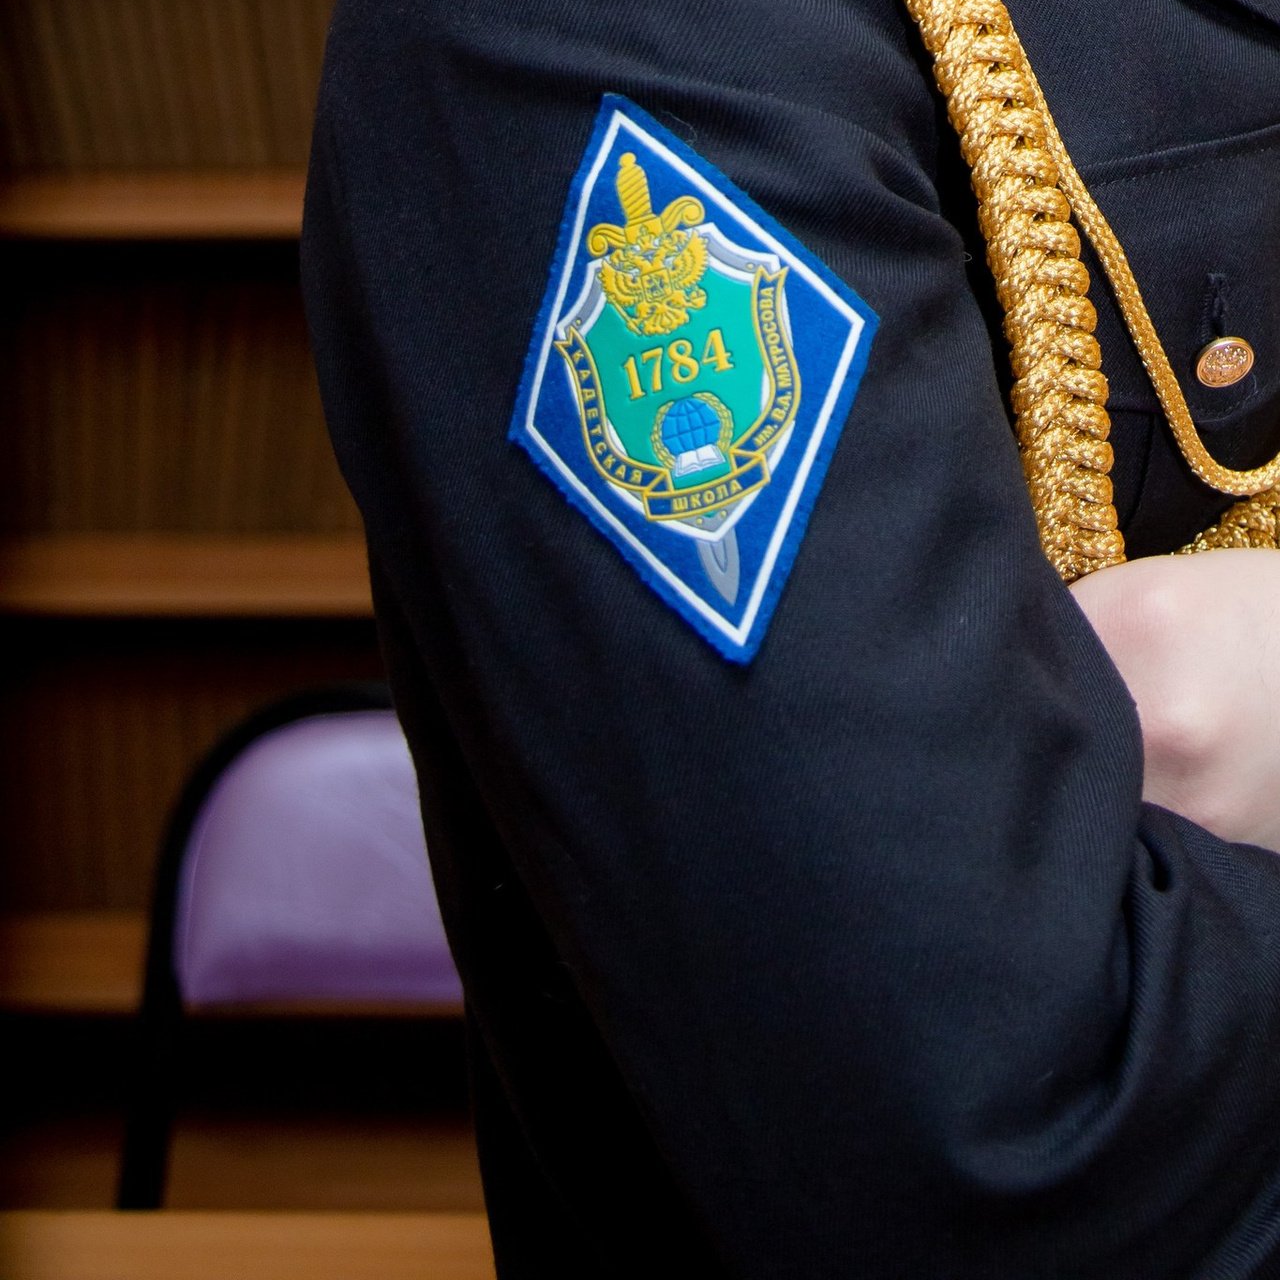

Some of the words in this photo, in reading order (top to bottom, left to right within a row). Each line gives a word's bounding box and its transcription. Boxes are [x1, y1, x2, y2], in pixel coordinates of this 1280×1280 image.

[623, 327, 734, 400] 1784
[760, 286, 792, 389] МАТРОСОВА
[571, 348, 643, 485] КАДЕТСКАЯ
[671, 482, 743, 513] ШКОЛА
